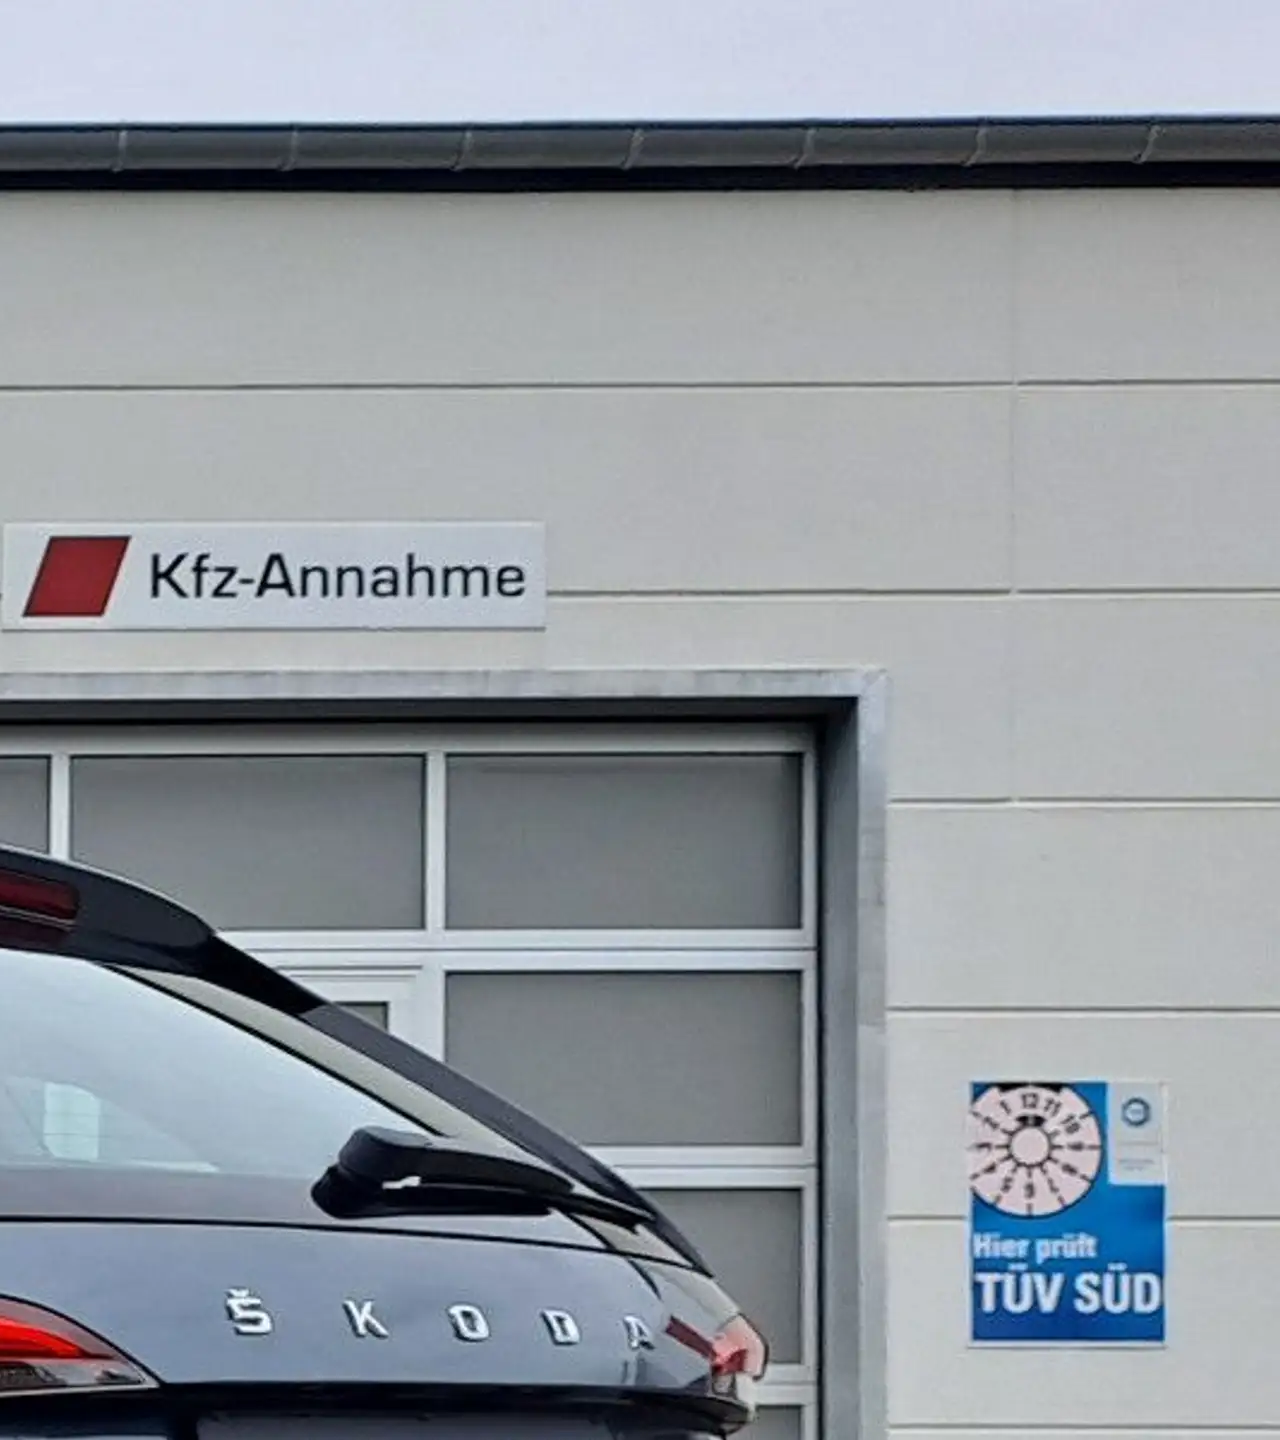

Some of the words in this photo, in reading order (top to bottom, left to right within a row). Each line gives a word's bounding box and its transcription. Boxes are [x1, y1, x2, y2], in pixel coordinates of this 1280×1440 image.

[149, 551, 526, 599] Kfz-Annahme
[972, 1232, 1030, 1259] Hier
[1036, 1232, 1097, 1264] prüft
[974, 1262, 1065, 1314] TÜV
[1073, 1262, 1162, 1314] SÜD
[225, 1288, 654, 1350] ŠKODA
